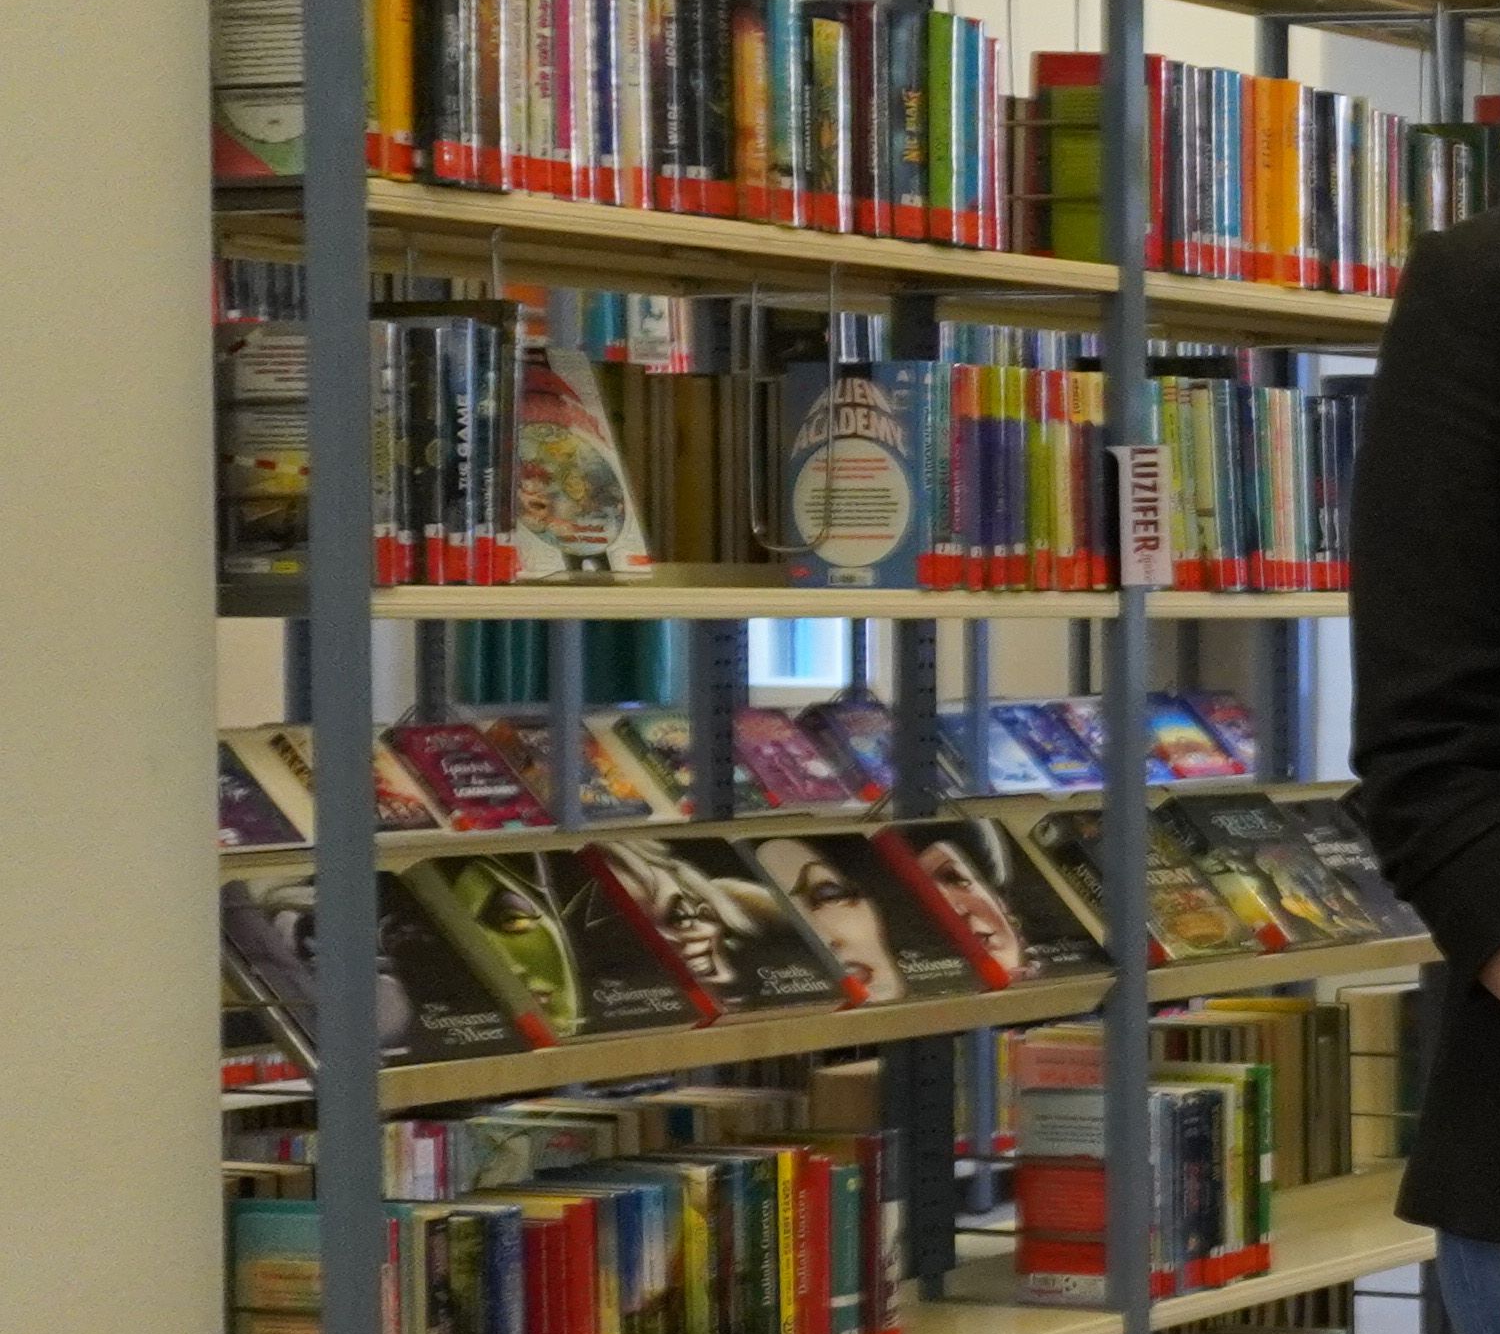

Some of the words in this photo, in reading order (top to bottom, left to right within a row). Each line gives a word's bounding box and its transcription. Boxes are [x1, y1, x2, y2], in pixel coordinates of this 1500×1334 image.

[456, 394, 472, 458] GAME
[1130, 446, 1160, 555] LUZIFER
[897, 957, 965, 974] Schönste
[458, 1025, 505, 1045] Meer
